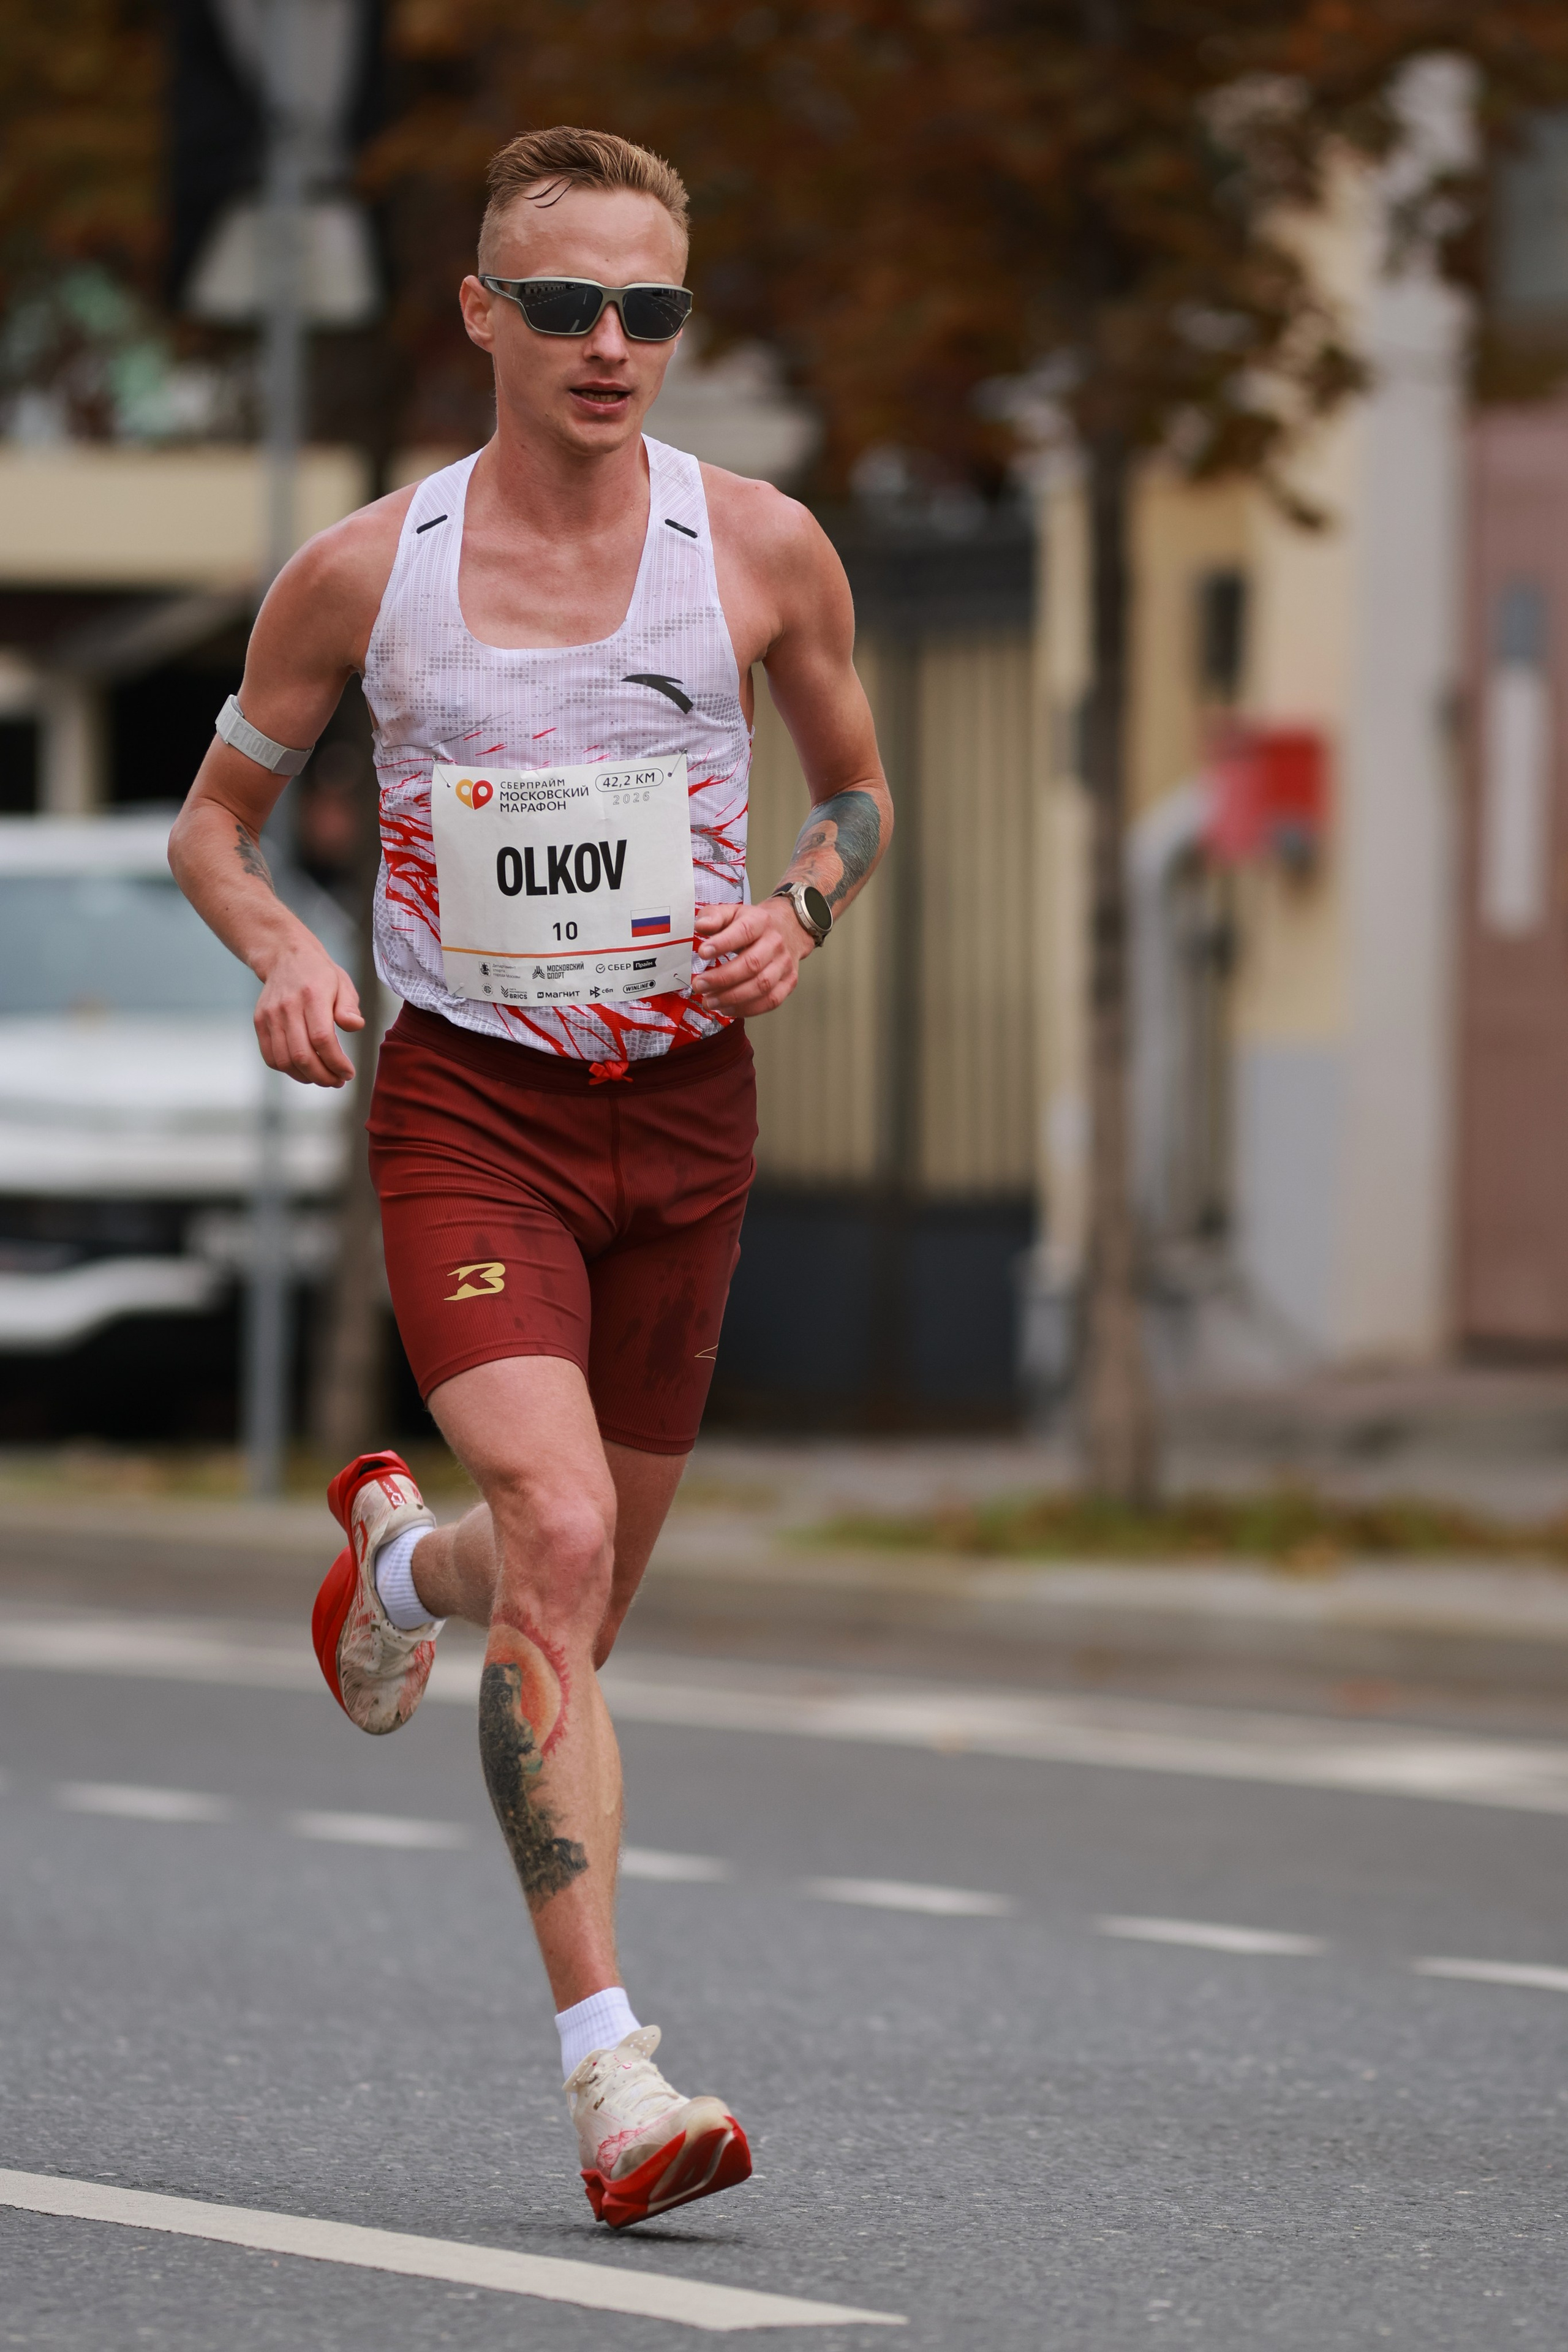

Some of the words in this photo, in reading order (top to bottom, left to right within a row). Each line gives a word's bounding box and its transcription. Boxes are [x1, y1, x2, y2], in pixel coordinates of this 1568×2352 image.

[500, 778, 565, 789] СБЕРПРАЙМ
[603, 775, 631, 788] 42,2
[500, 785, 589, 801] МОСКОВСКИЙ
[612, 791, 650, 805] 2026
[500, 800, 567, 812] МАРАФОН
[497, 839, 627, 896] OLKOV
[552, 921, 578, 941] 10
[547, 962, 584, 972] МОСКОВСКИЙ
[626, 983, 649, 992] WINLINE
